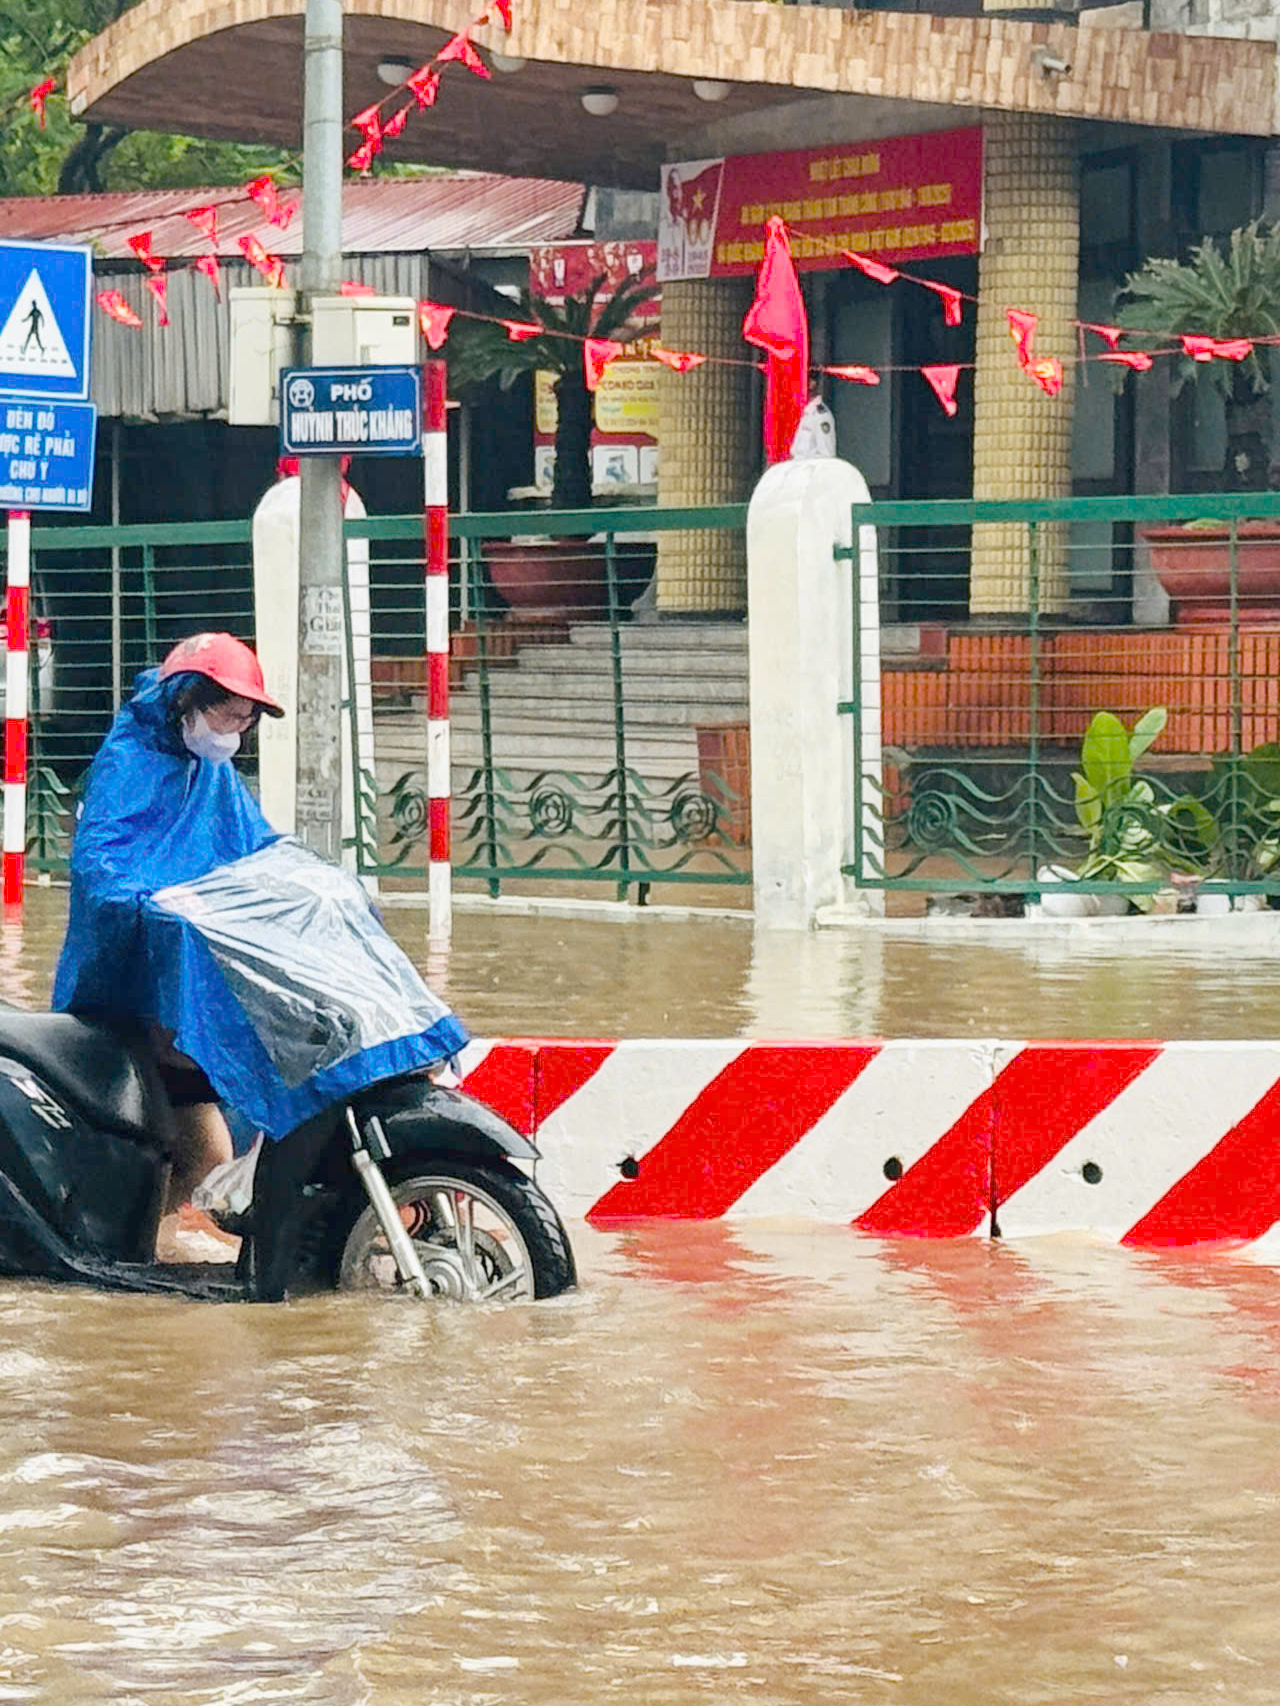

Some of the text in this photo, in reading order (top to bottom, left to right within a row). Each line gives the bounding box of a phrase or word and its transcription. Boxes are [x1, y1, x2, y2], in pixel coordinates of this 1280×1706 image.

[330, 376, 374, 402] PHỐ
[6, 405, 55, 432] ĐÈN ĐỎ
[291, 403, 413, 443] HUỲNH THÚC KHÁNG
[44, 429, 75, 458] PHẢI
[9, 457, 37, 480] CHÚ
